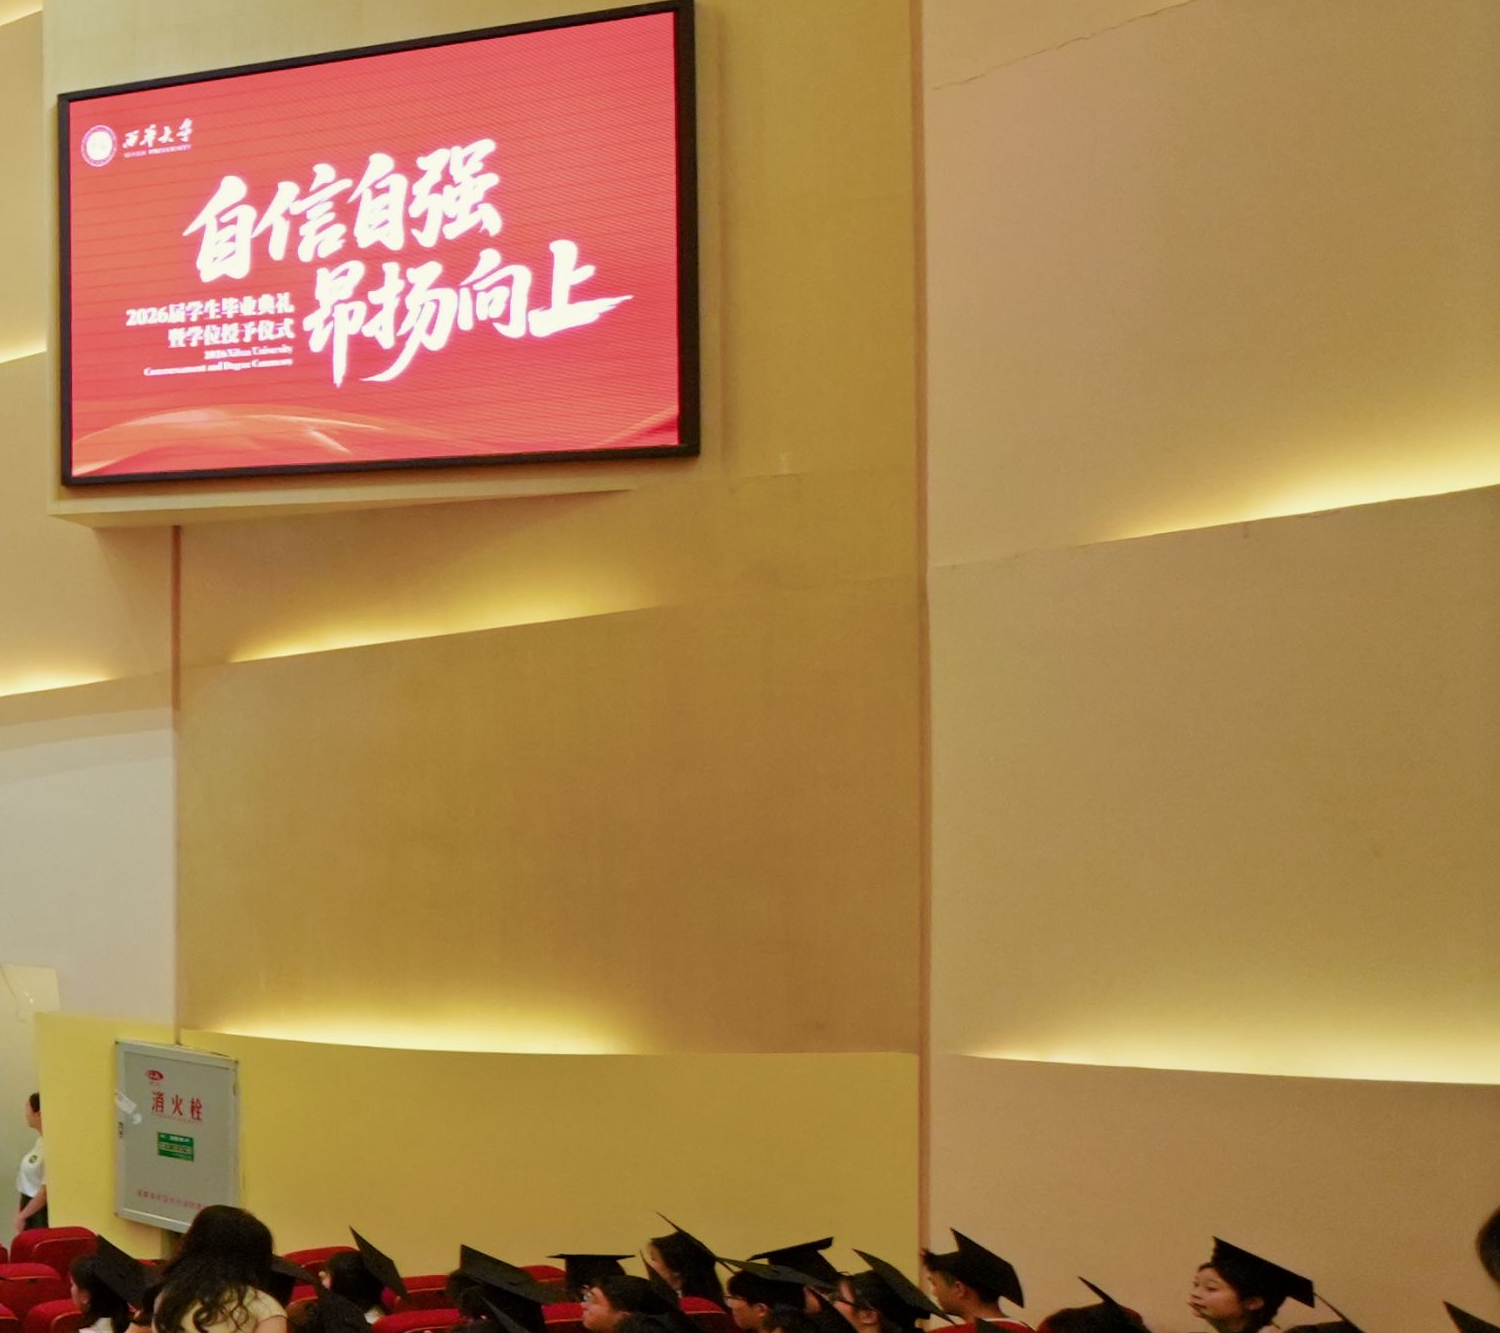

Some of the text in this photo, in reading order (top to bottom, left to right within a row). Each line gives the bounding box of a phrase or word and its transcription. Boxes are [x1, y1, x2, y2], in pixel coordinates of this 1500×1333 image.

[182, 138, 502, 284] 自信自强
[125, 292, 296, 327] 2026届学生毕业典礼
[303, 239, 634, 388] 昂扬向上
[151, 1091, 203, 1121] 消火栓
